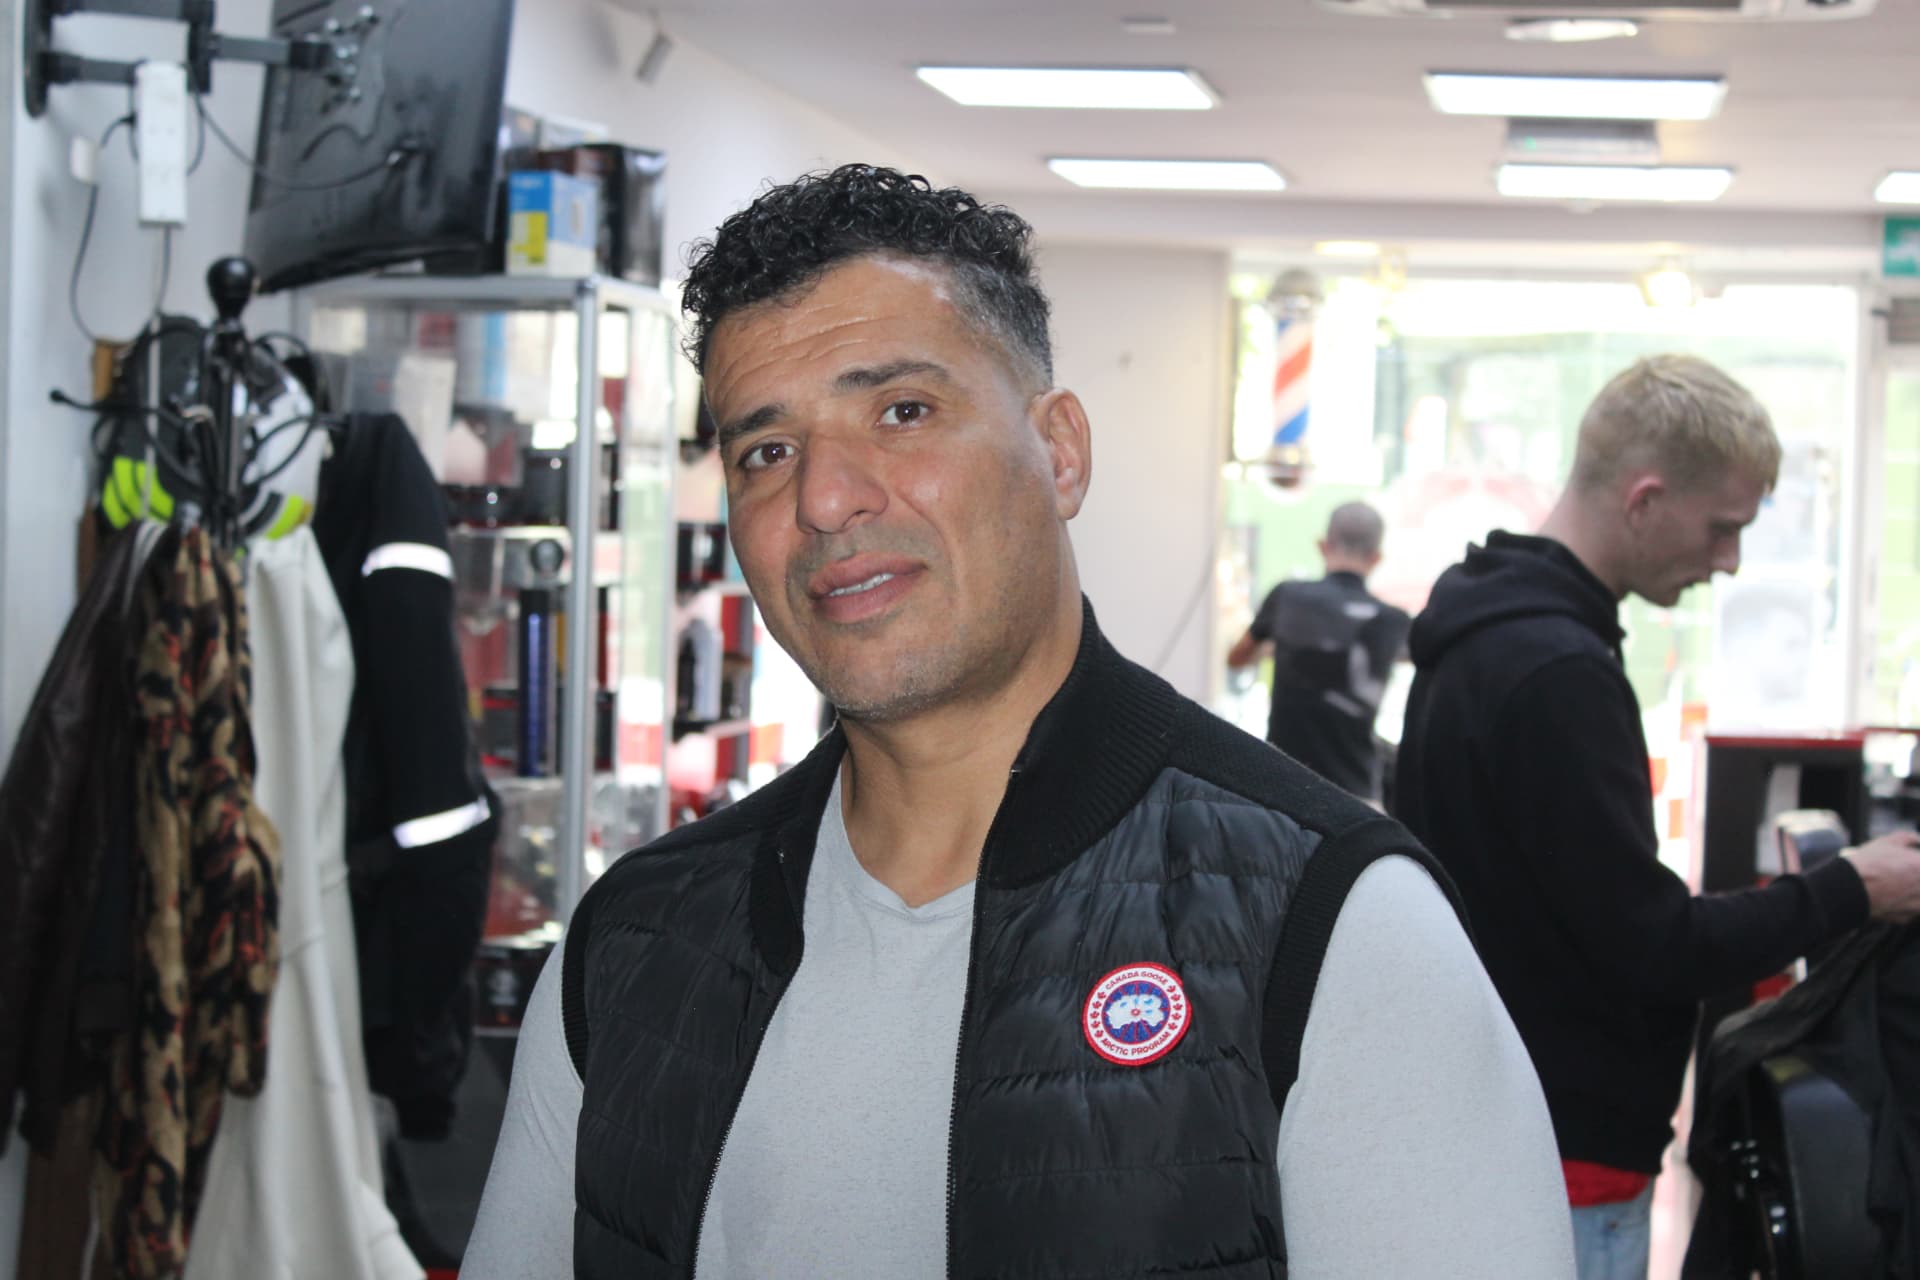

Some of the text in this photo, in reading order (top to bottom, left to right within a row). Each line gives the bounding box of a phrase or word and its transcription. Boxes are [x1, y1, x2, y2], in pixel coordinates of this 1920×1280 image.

[1105, 971, 1168, 990] CANADA GOOSE
[1101, 1031, 1171, 1056] ARCTIC PROGRAM
